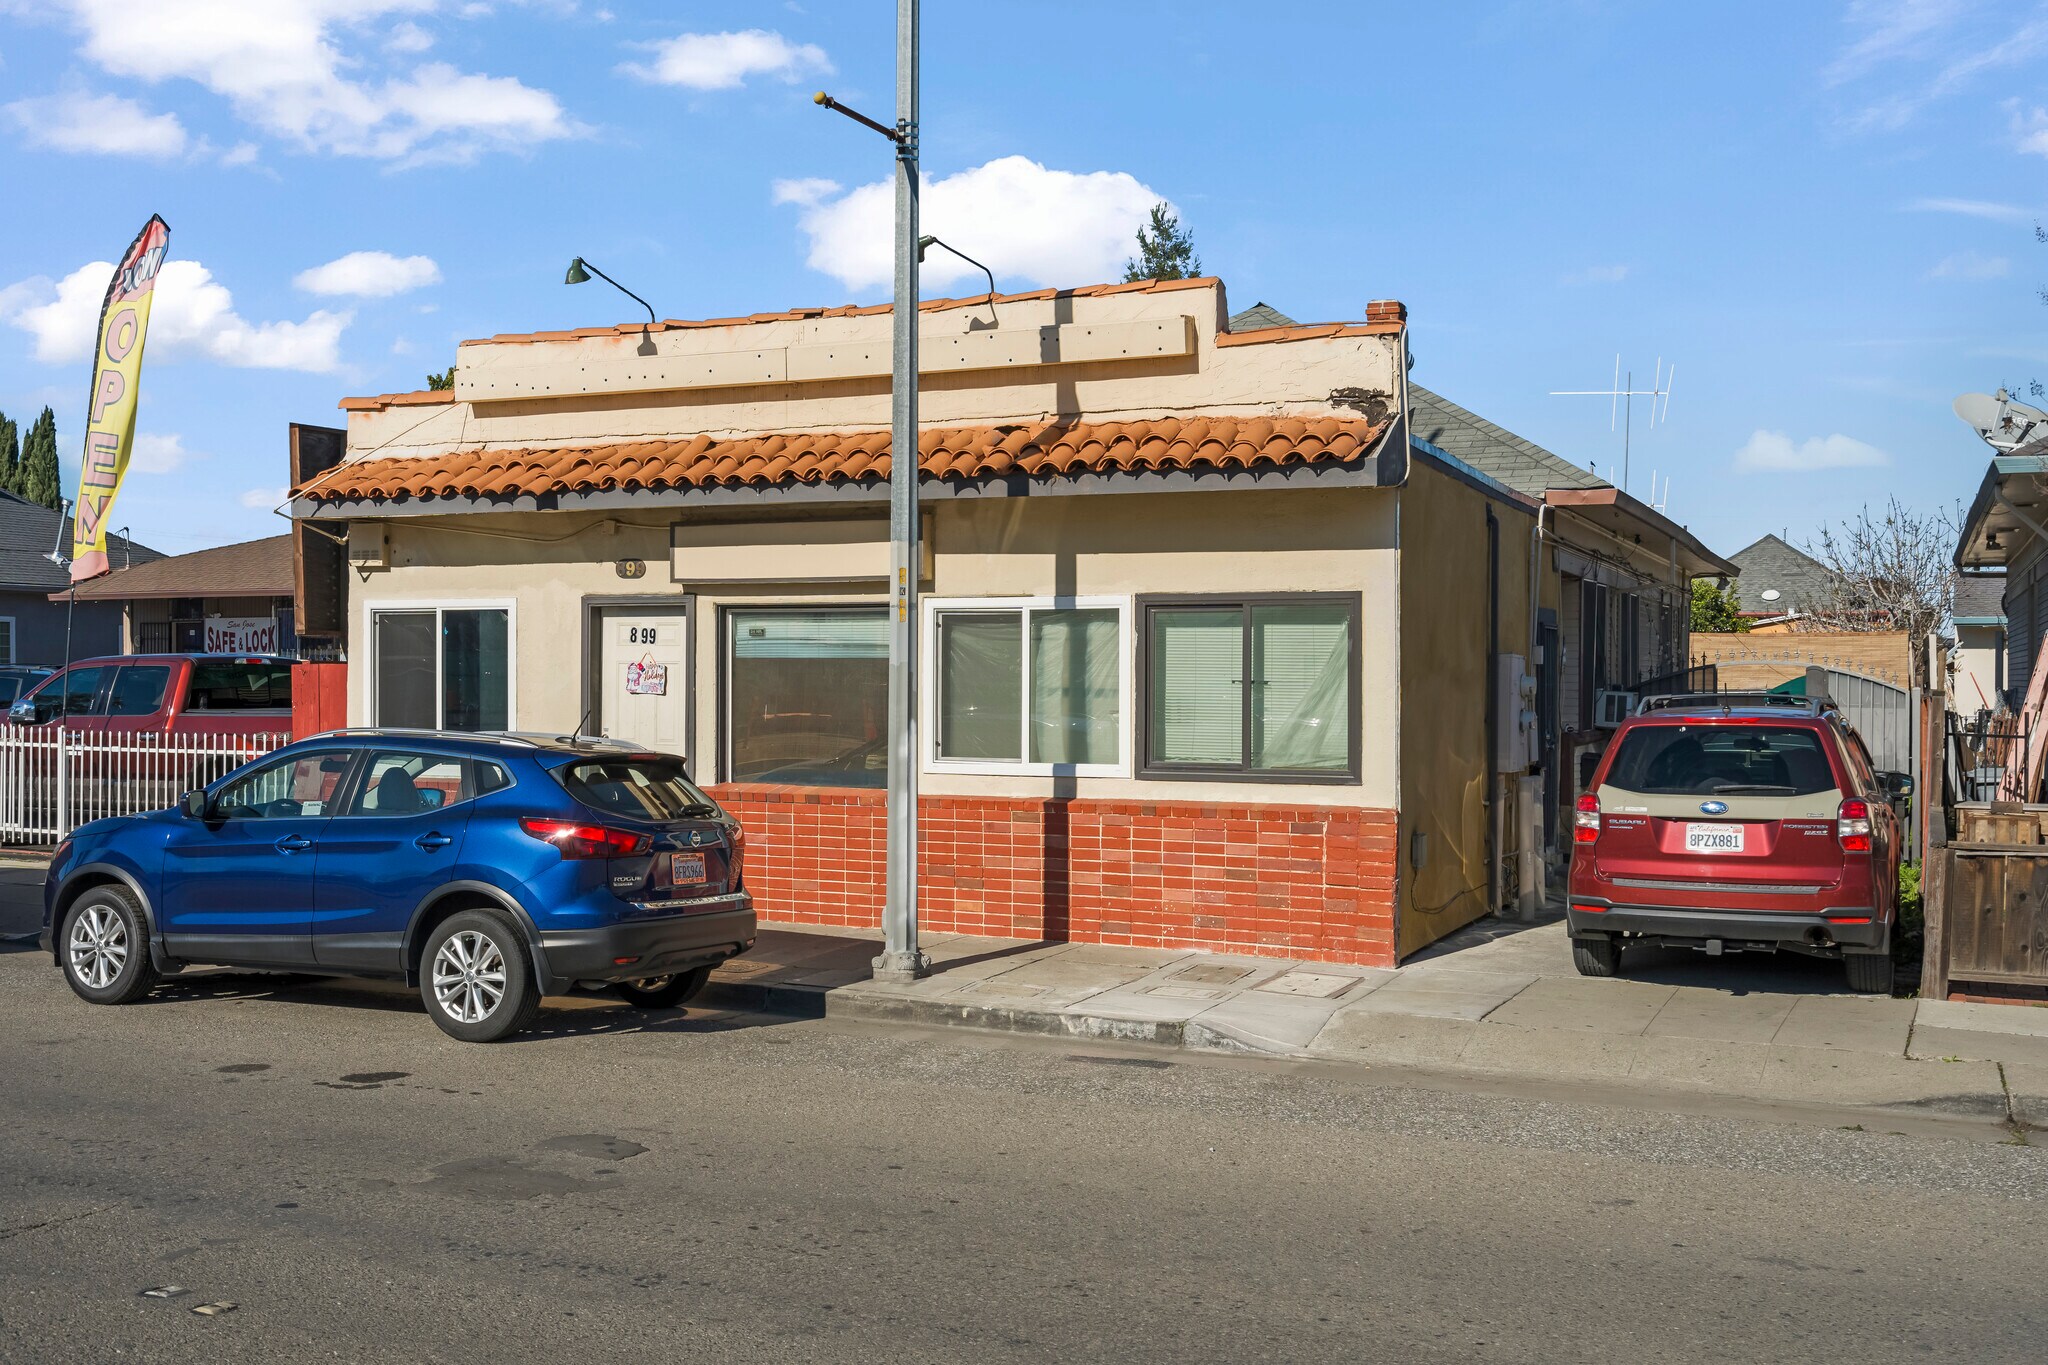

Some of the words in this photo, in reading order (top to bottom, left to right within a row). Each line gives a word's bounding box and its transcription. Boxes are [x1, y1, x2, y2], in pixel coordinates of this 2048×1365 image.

[75, 308, 138, 546] OPEN
[227, 620, 240, 628] San
[242, 620, 256, 630] Jose
[207, 626, 236, 653] SAFE
[238, 637, 244, 650] &
[245, 625, 276, 653] LOCK
[1689, 833, 1740, 848] 8PZX881
[674, 864, 703, 879] 8FRS966
